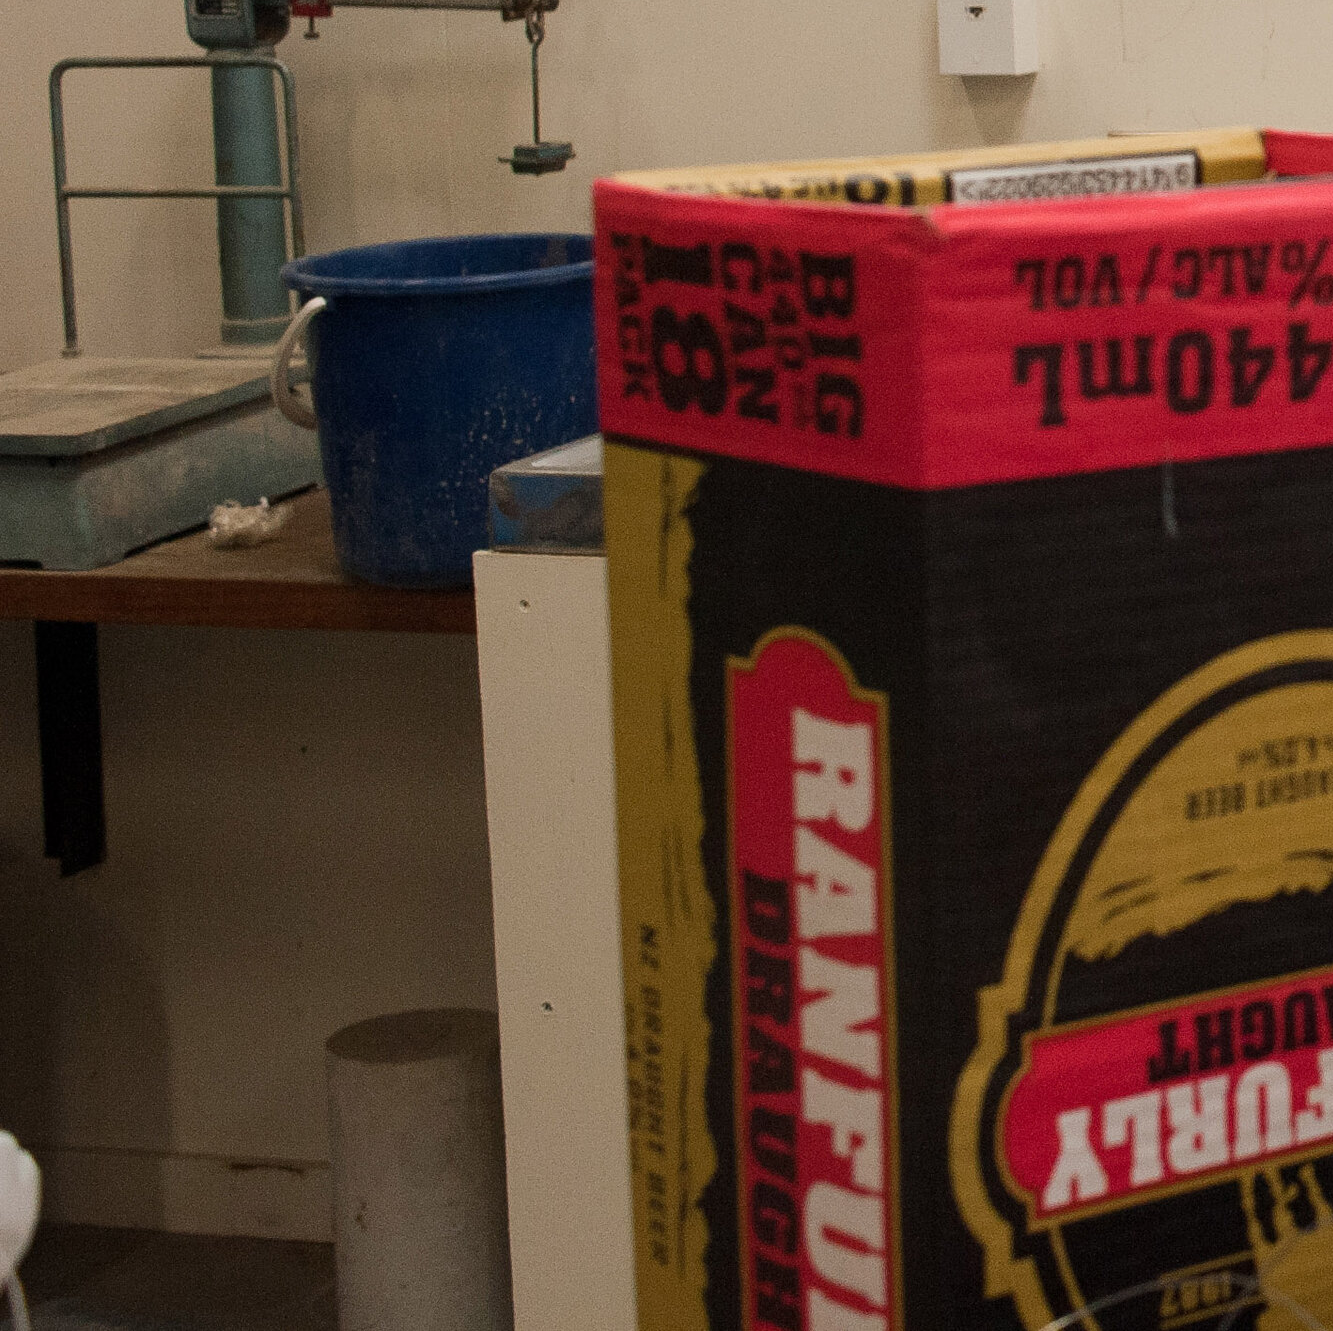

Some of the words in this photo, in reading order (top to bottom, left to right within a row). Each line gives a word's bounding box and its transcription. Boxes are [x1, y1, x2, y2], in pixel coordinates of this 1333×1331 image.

[610, 231, 651, 403] PACK
[641, 235, 728, 416] 18
[720, 241, 781, 424] CAN
[798, 249, 866, 439] BIG
[1185, 783, 1245, 821] BEER
